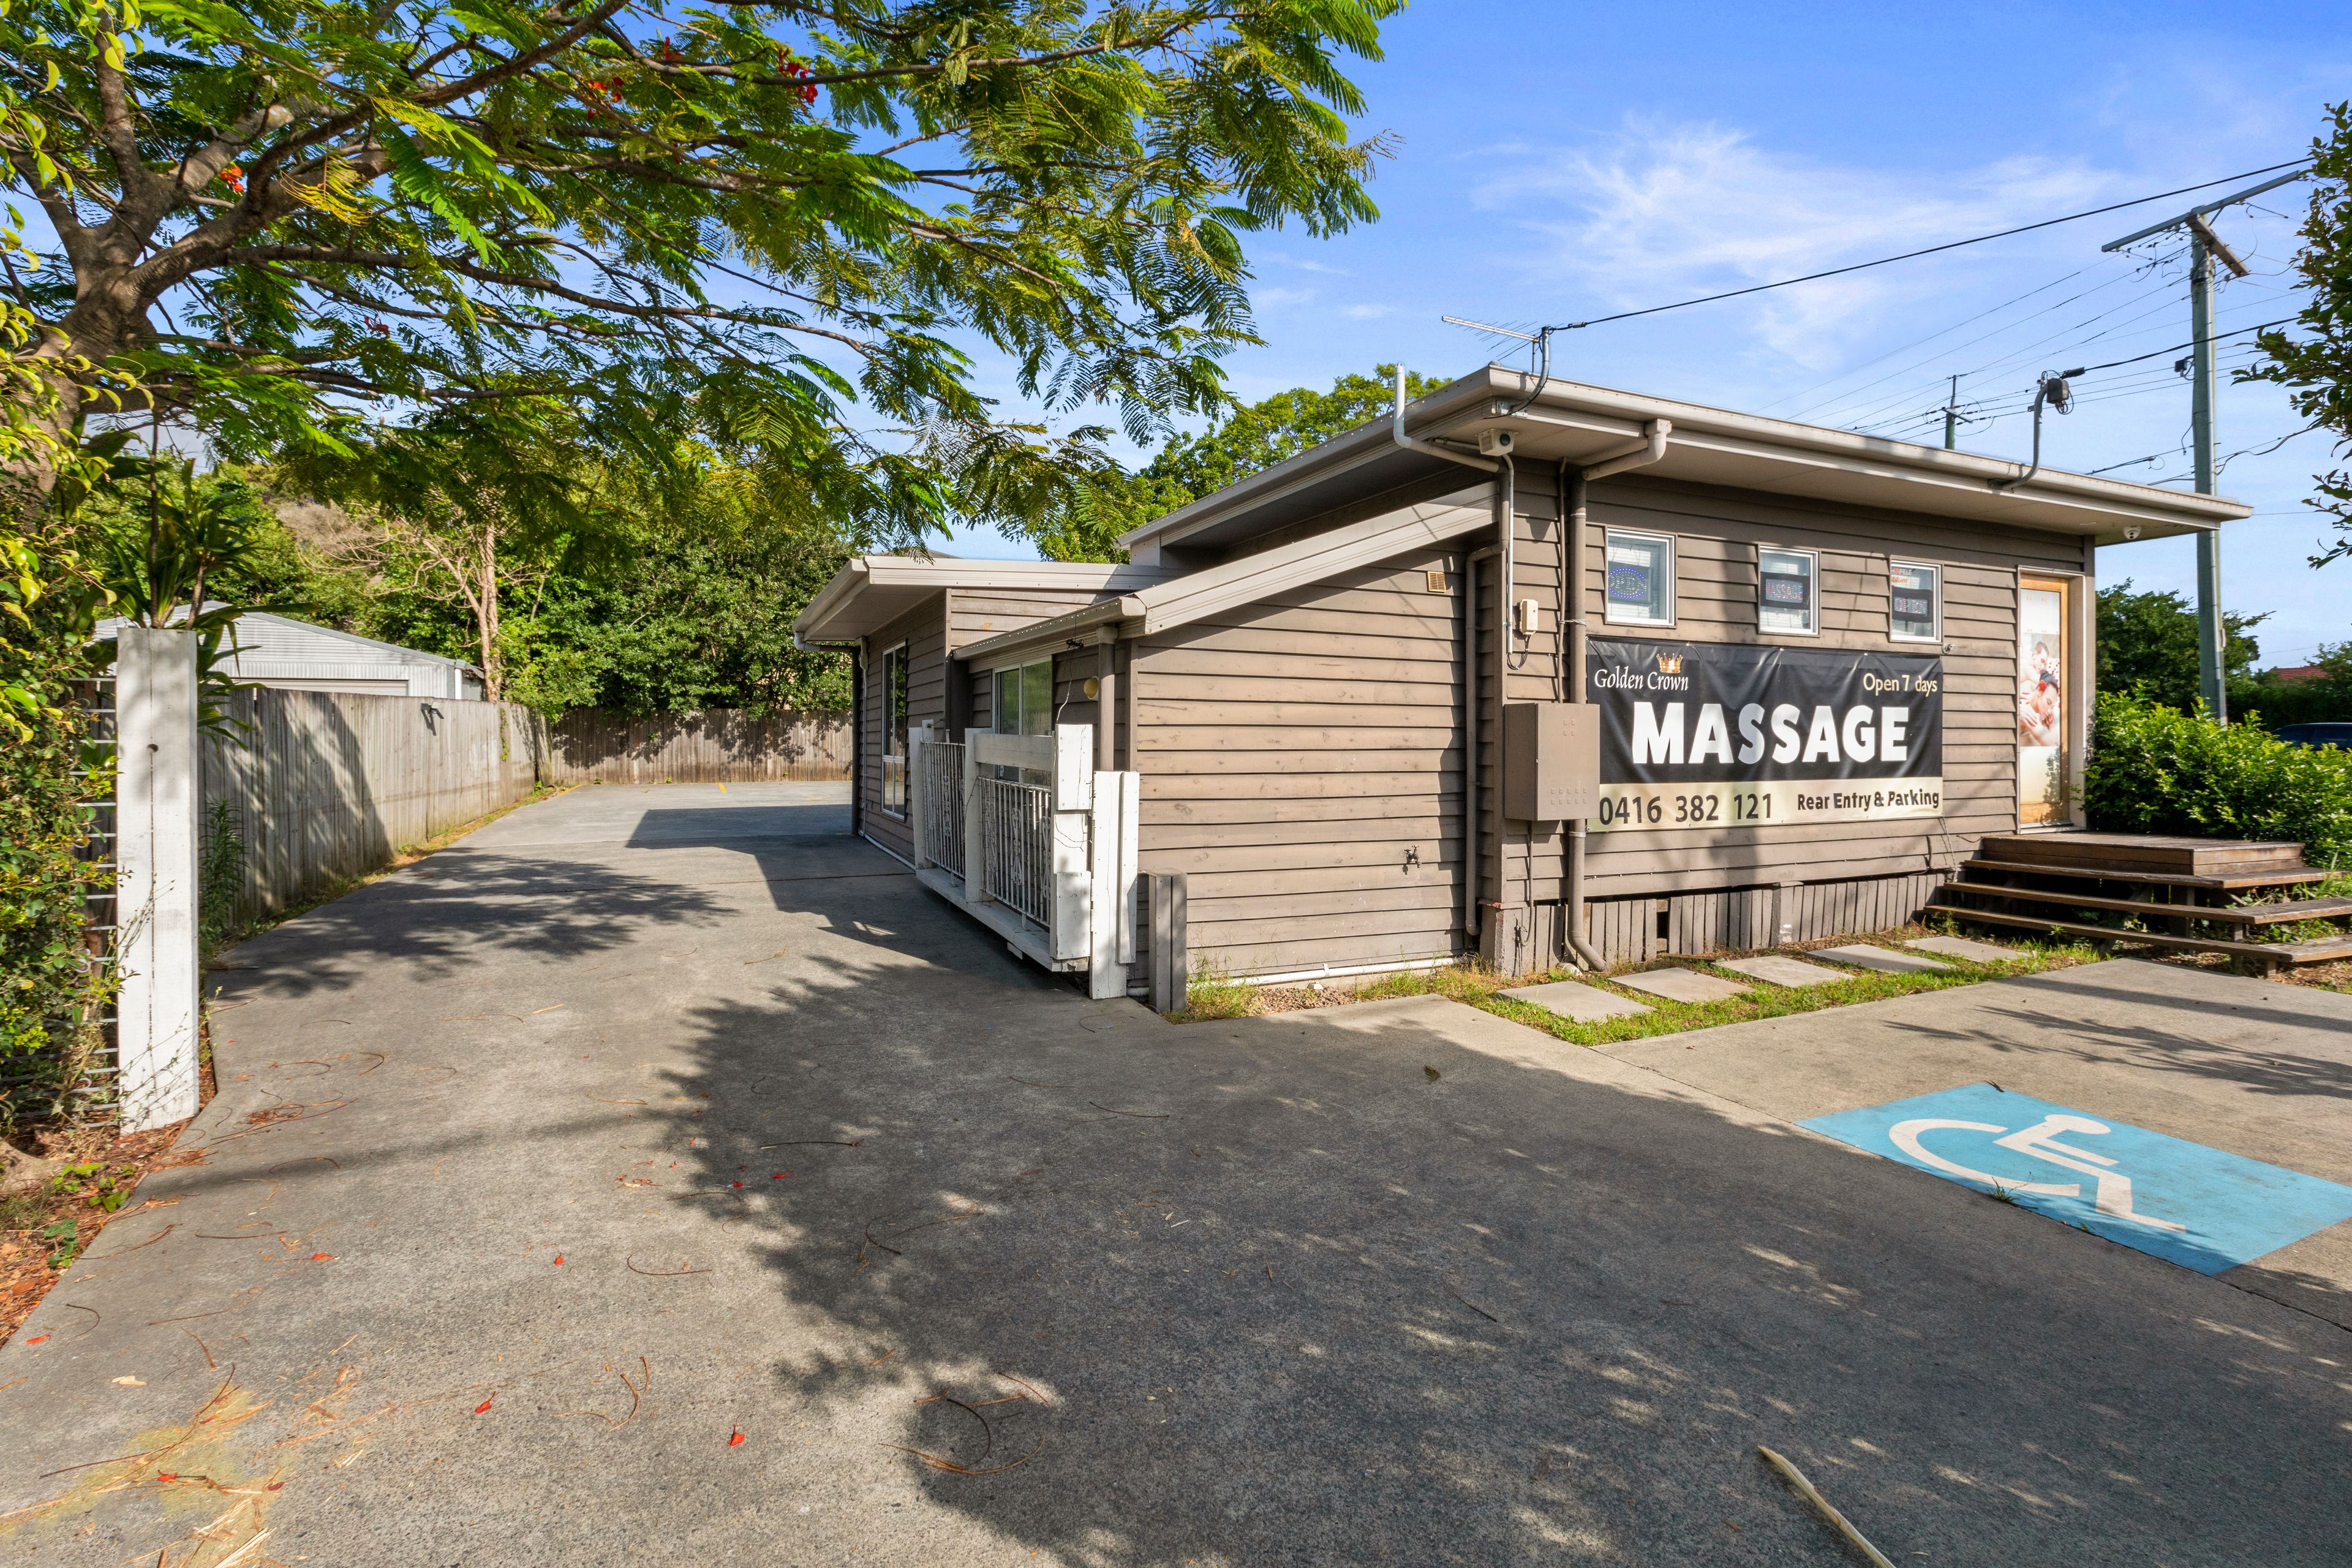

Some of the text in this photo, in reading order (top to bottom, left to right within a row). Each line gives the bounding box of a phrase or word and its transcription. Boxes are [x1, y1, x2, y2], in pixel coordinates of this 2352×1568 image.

[1594, 665, 1689, 691] Golden Crown
[1863, 673, 1937, 697] Open 7 days
[1632, 701, 1909, 765] MASSAGE
[1599, 793, 1771, 825] 0416 382 121
[1798, 788, 1939, 812] Rear Entry & Parking
